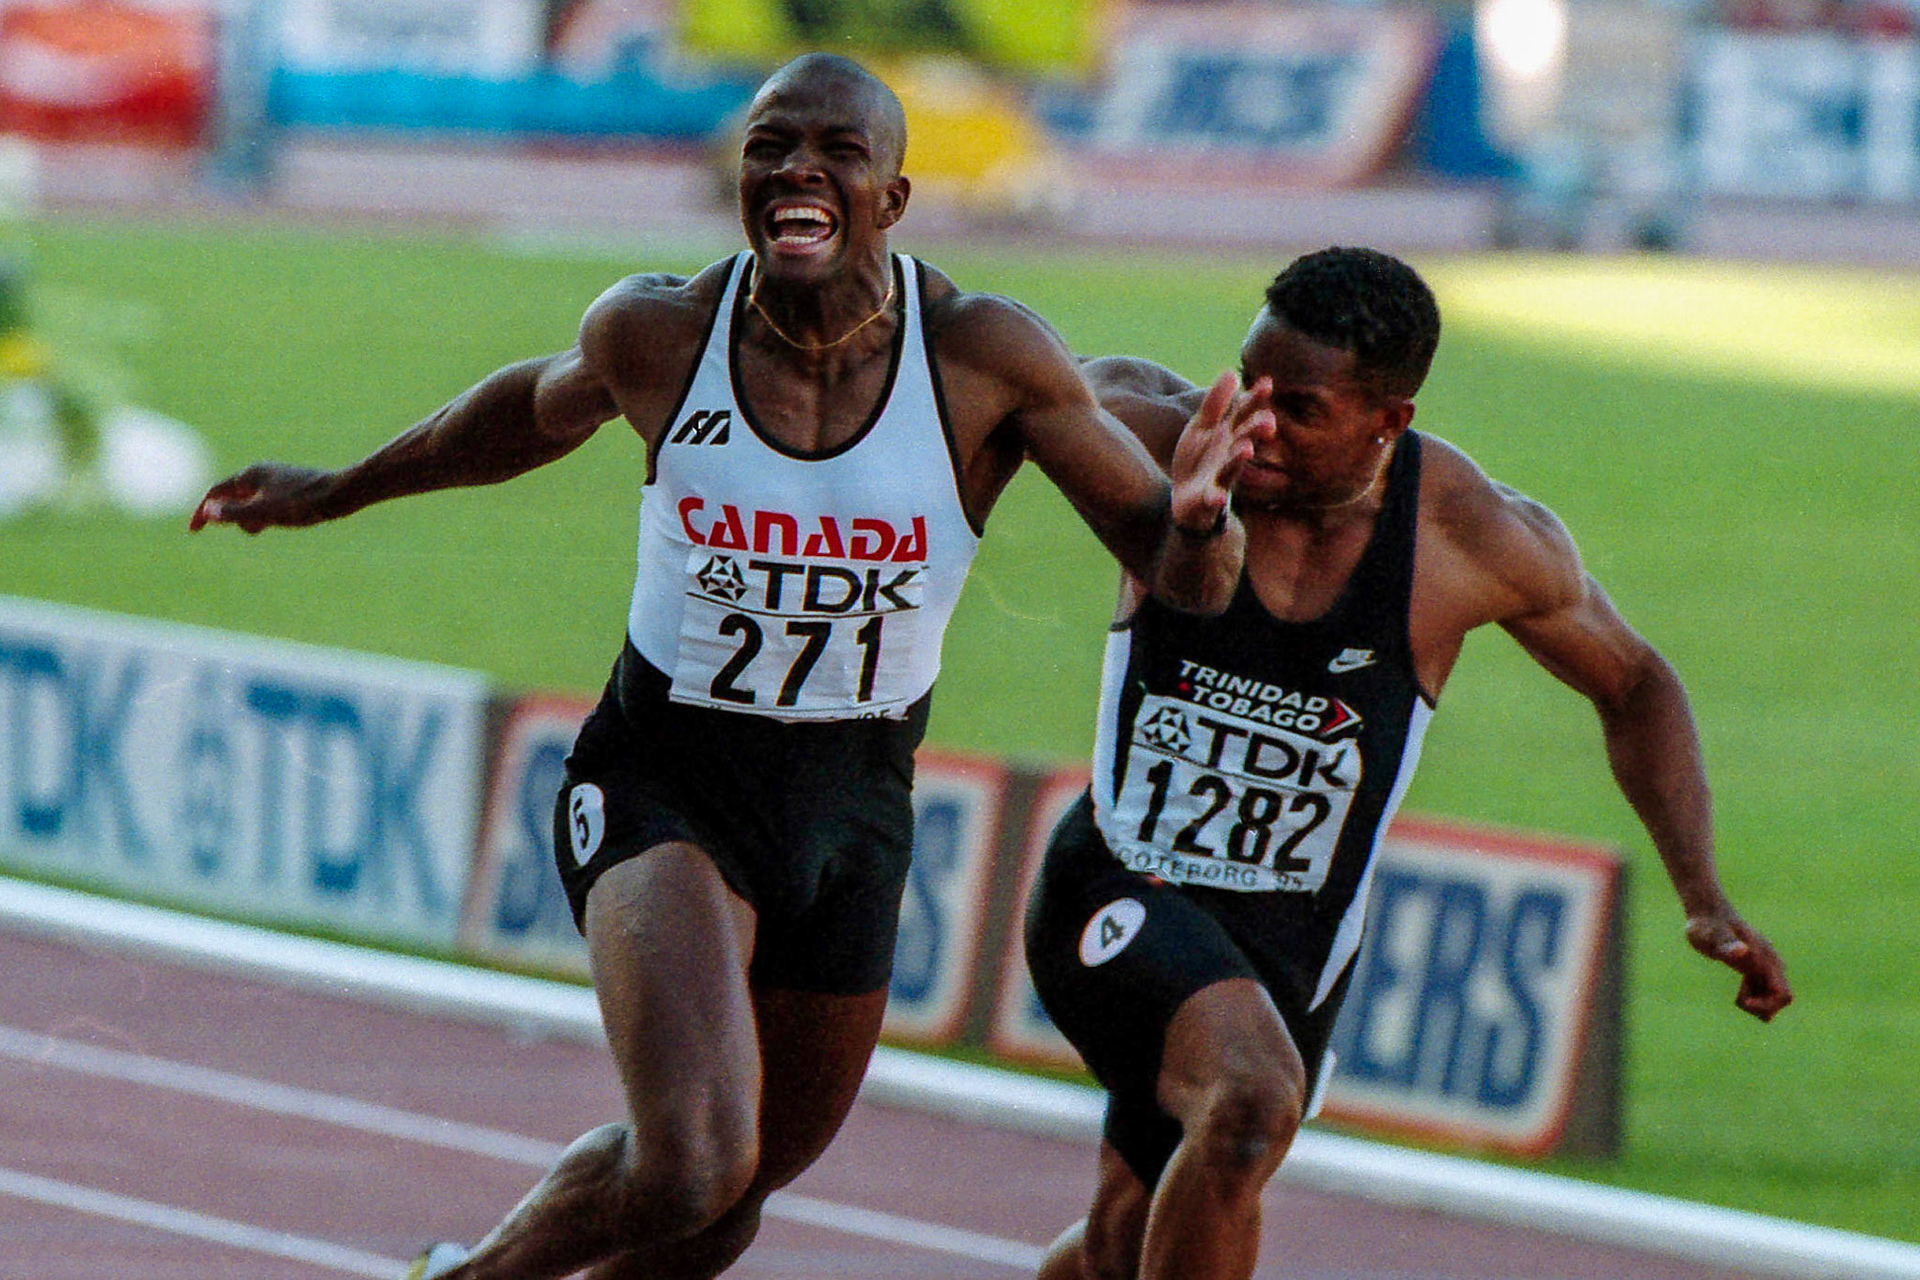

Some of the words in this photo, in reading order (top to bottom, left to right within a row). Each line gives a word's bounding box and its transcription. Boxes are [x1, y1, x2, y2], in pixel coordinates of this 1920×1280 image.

[677, 497, 927, 563] CANADA
[748, 559, 922, 613] TDK
[709, 612, 884, 707] 271
[1180, 659, 1329, 713] TRINIDAD
[1191, 684, 1322, 732] TOBAGO
[1197, 716, 1348, 788] TDK
[1137, 759, 1331, 872] 1282
[1101, 914, 1124, 949] 4
